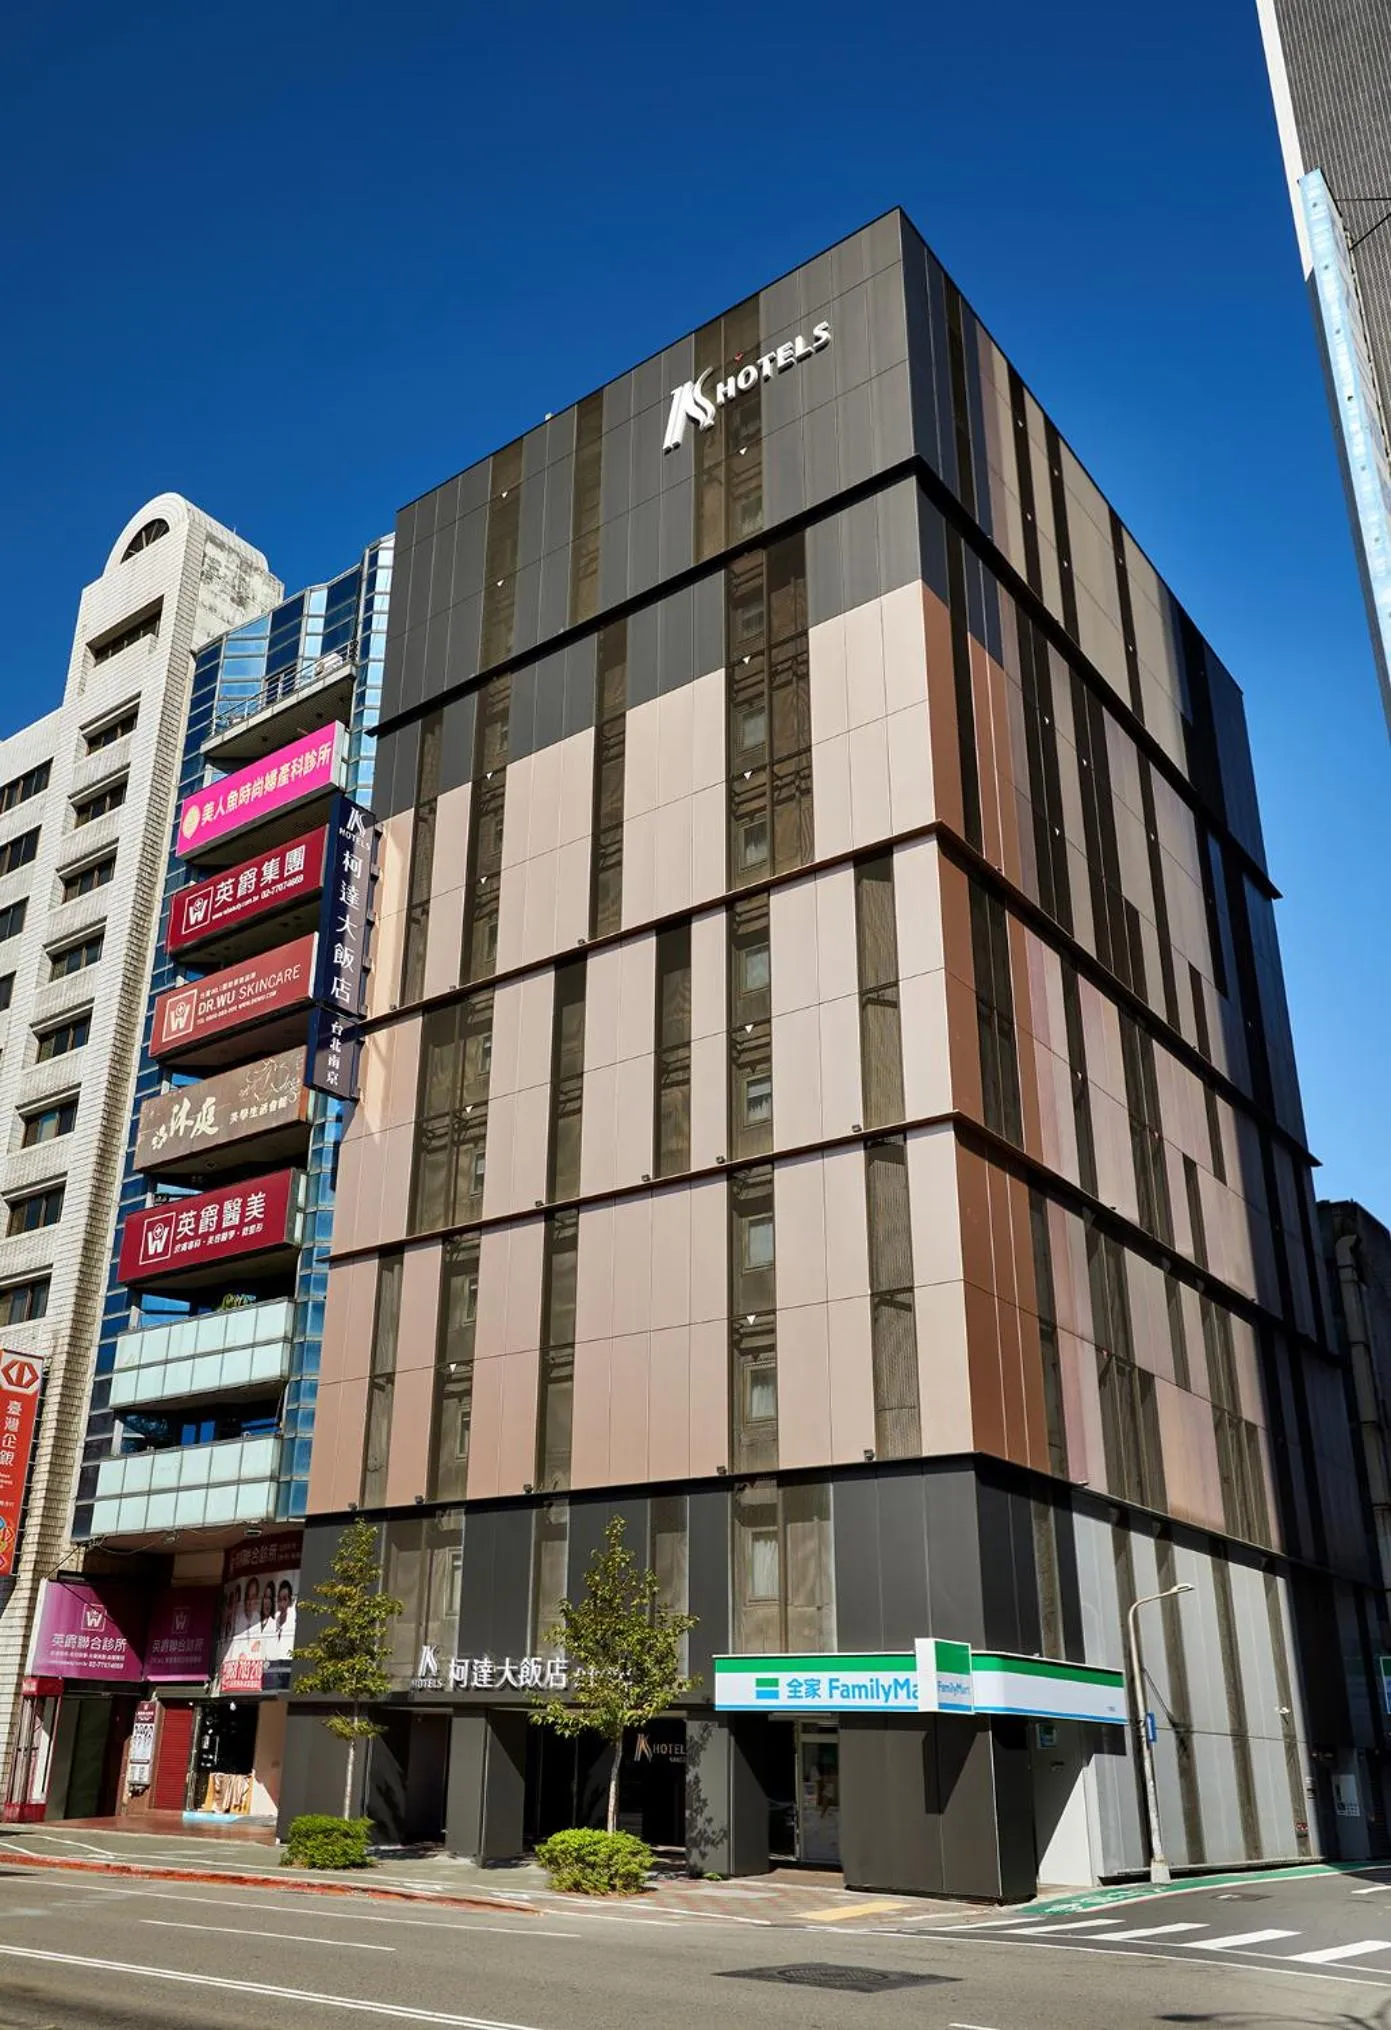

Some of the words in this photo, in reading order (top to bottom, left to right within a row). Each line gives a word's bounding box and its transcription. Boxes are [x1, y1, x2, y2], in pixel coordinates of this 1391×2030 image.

[716, 321, 832, 405] HOTELS
[214, 844, 306, 908] 英爵集團
[331, 850, 363, 1004] 柯達大飯店
[199, 990, 235, 1016] DR.WU
[238, 964, 301, 1000] SKINCARE
[326, 1020, 343, 1086] 台北南京
[176, 1191, 266, 1240] 英爵醫美
[450, 1657, 569, 1690] 柯達大飯店
[786, 1678, 821, 1700] 全家
